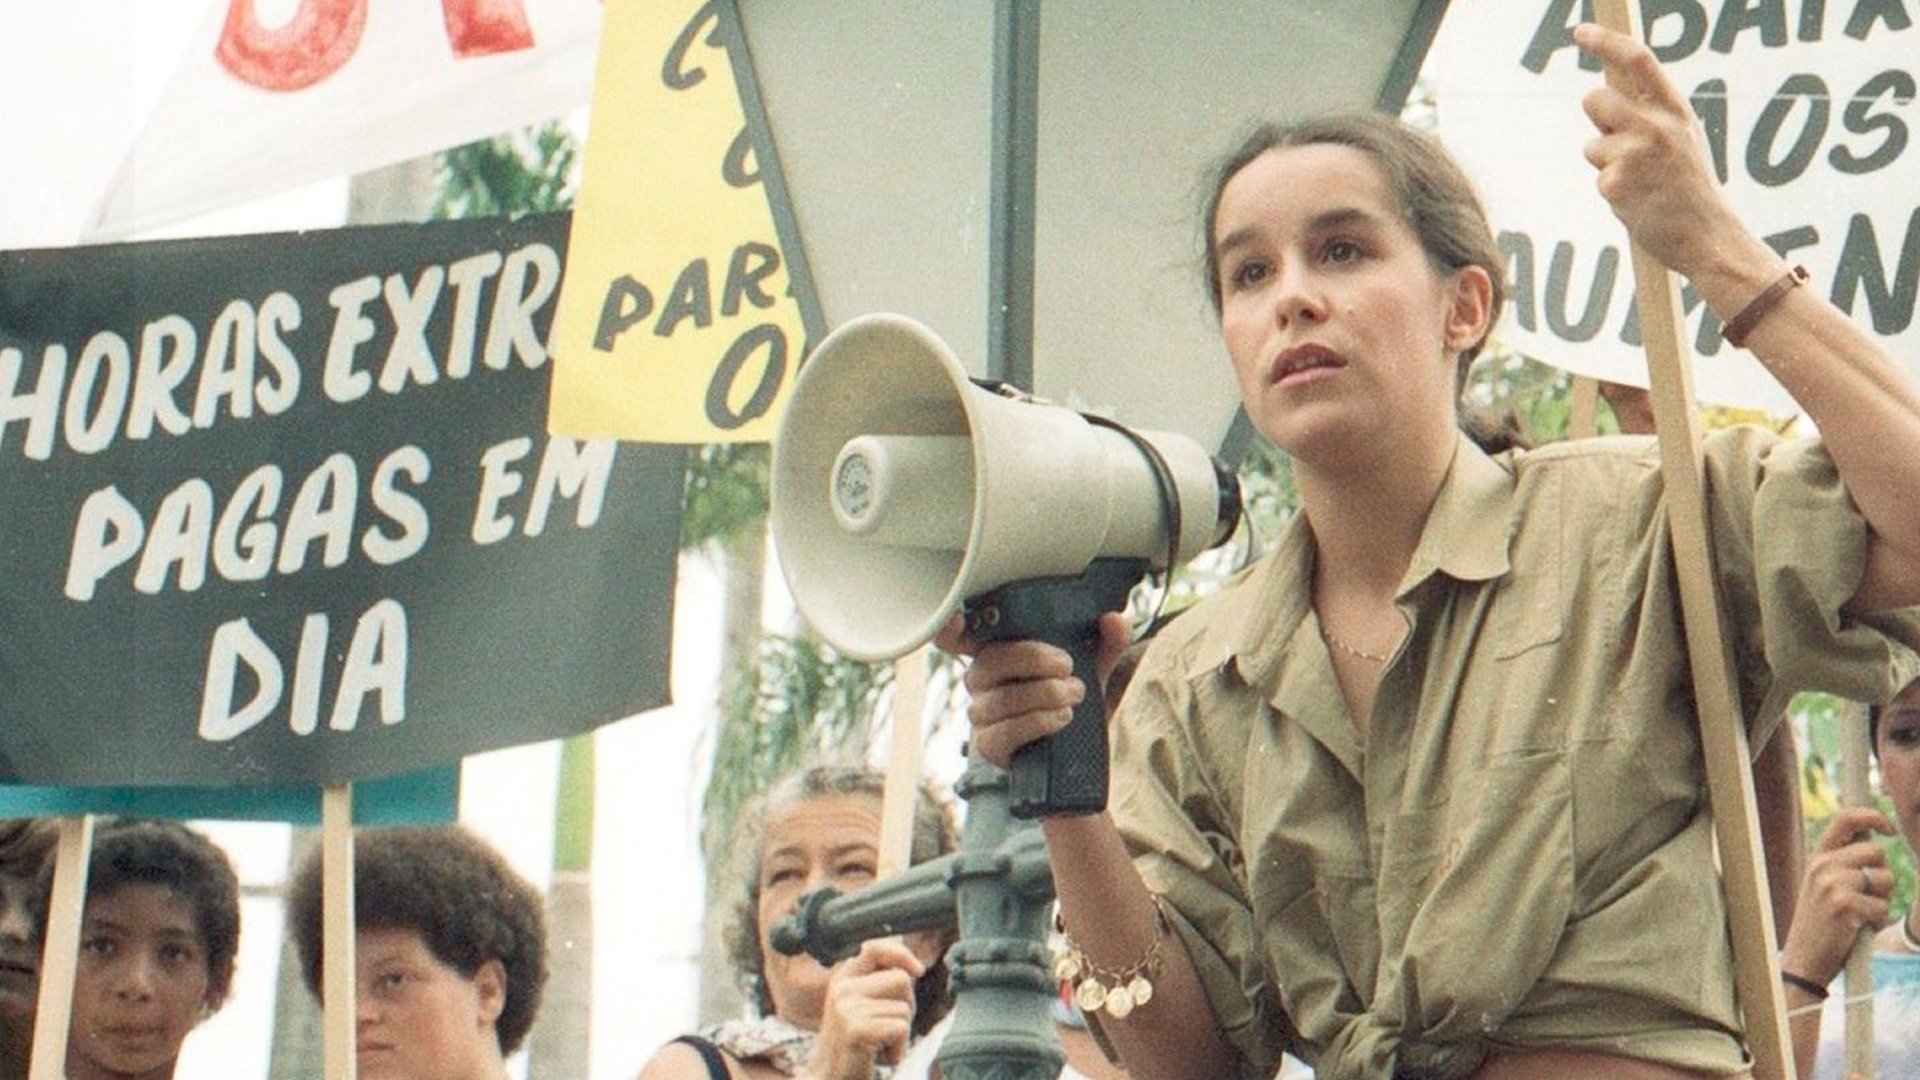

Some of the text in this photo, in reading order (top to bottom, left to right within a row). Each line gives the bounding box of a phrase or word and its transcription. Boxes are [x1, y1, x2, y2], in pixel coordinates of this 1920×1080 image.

[0, 243, 561, 458] HORAS EXTR
[593, 242, 796, 352] PAR
[1497, 207, 1920, 356] AUN
[64, 436, 618, 601] PAGAS EM
[198, 599, 408, 741] DIA
